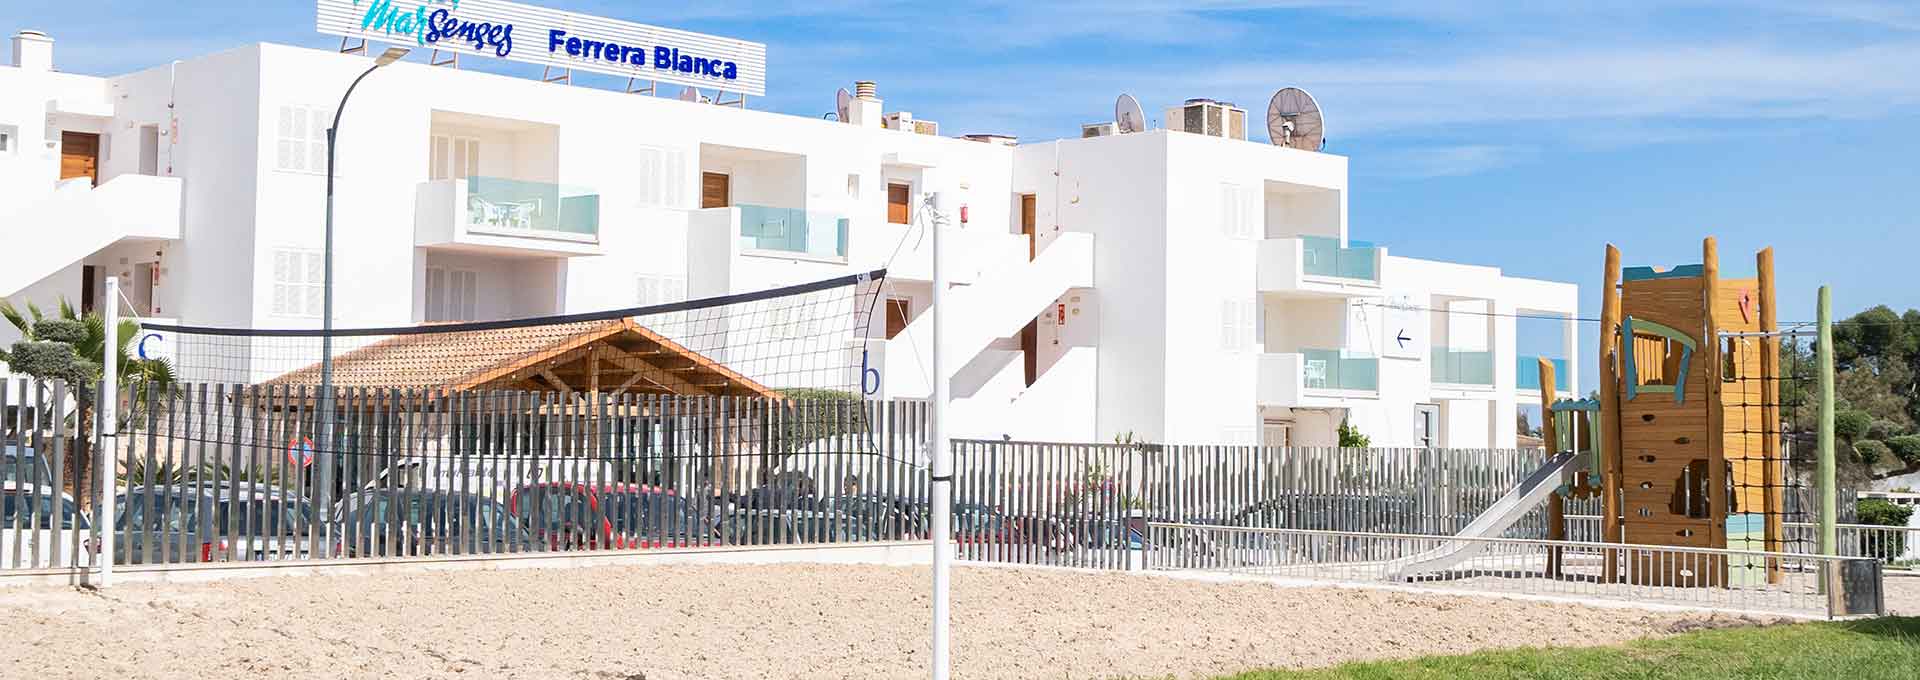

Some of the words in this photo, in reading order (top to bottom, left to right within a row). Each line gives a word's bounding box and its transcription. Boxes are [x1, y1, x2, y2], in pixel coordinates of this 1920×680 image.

[549, 29, 646, 66] Ferrera
[654, 46, 738, 80] Blanca
[862, 350, 880, 395] b
